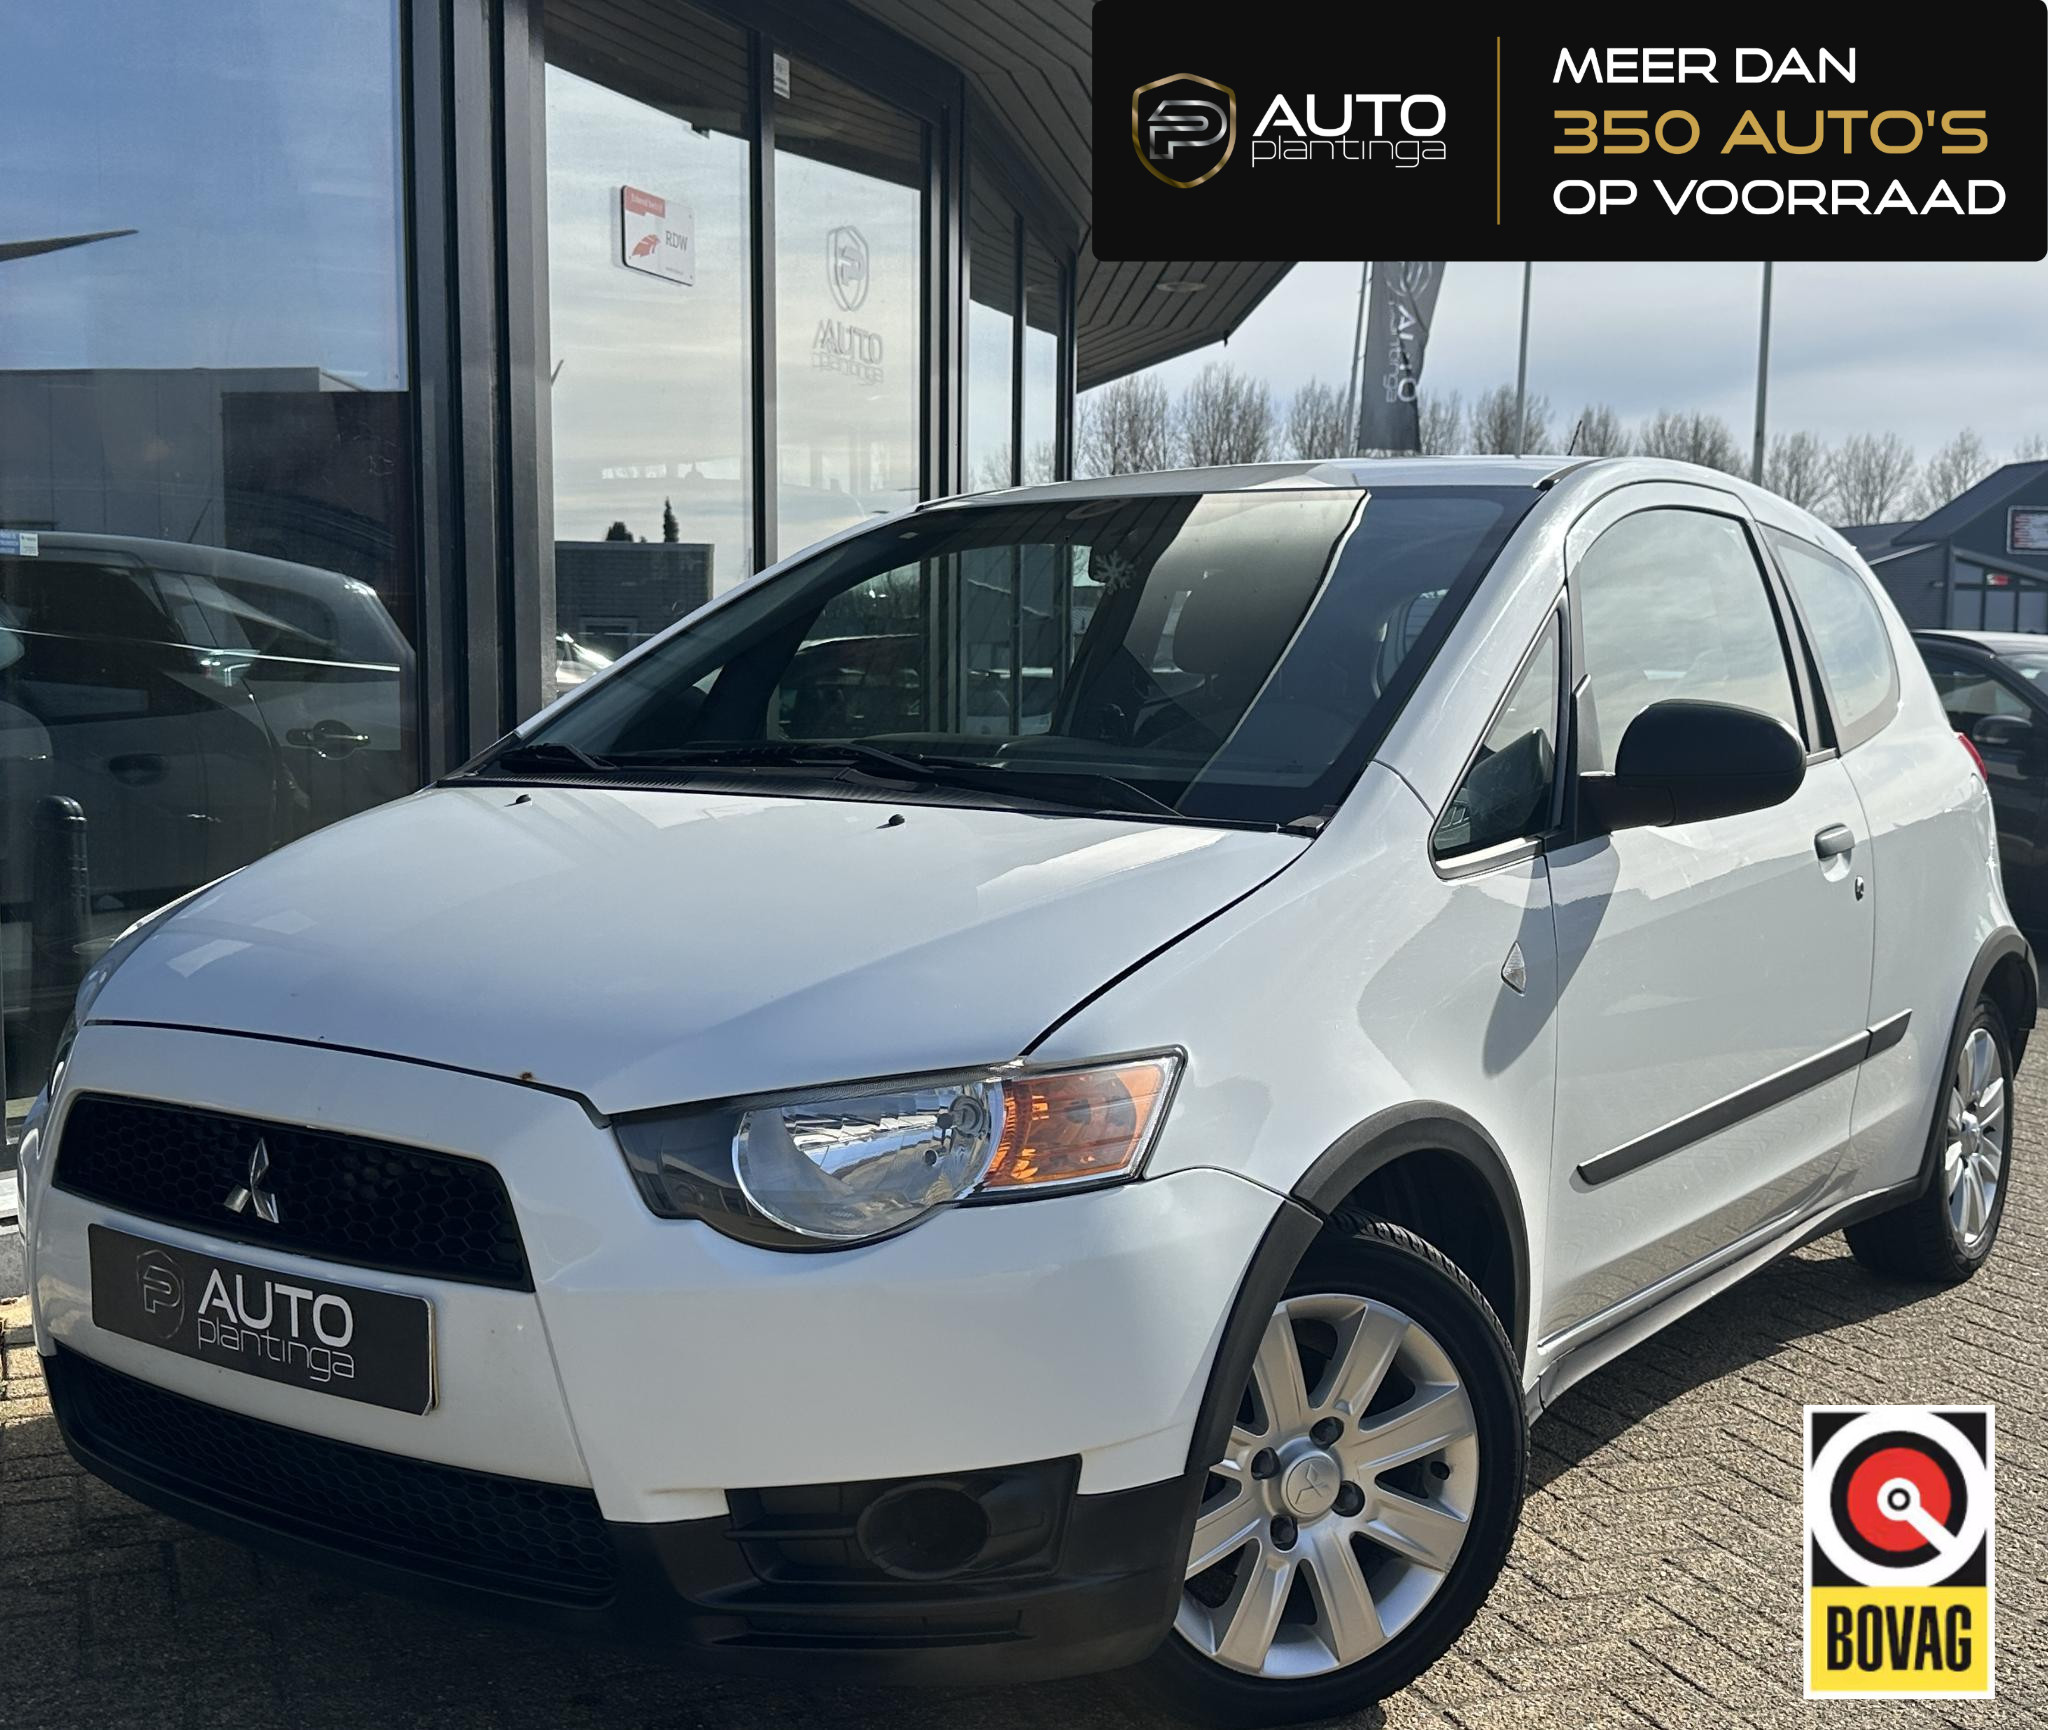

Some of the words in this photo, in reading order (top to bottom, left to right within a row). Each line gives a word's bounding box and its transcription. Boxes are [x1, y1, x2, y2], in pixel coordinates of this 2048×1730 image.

[665, 229, 688, 252] RDW
[198, 1268, 354, 1347] AUTO
[198, 1317, 355, 1382] plantinga
